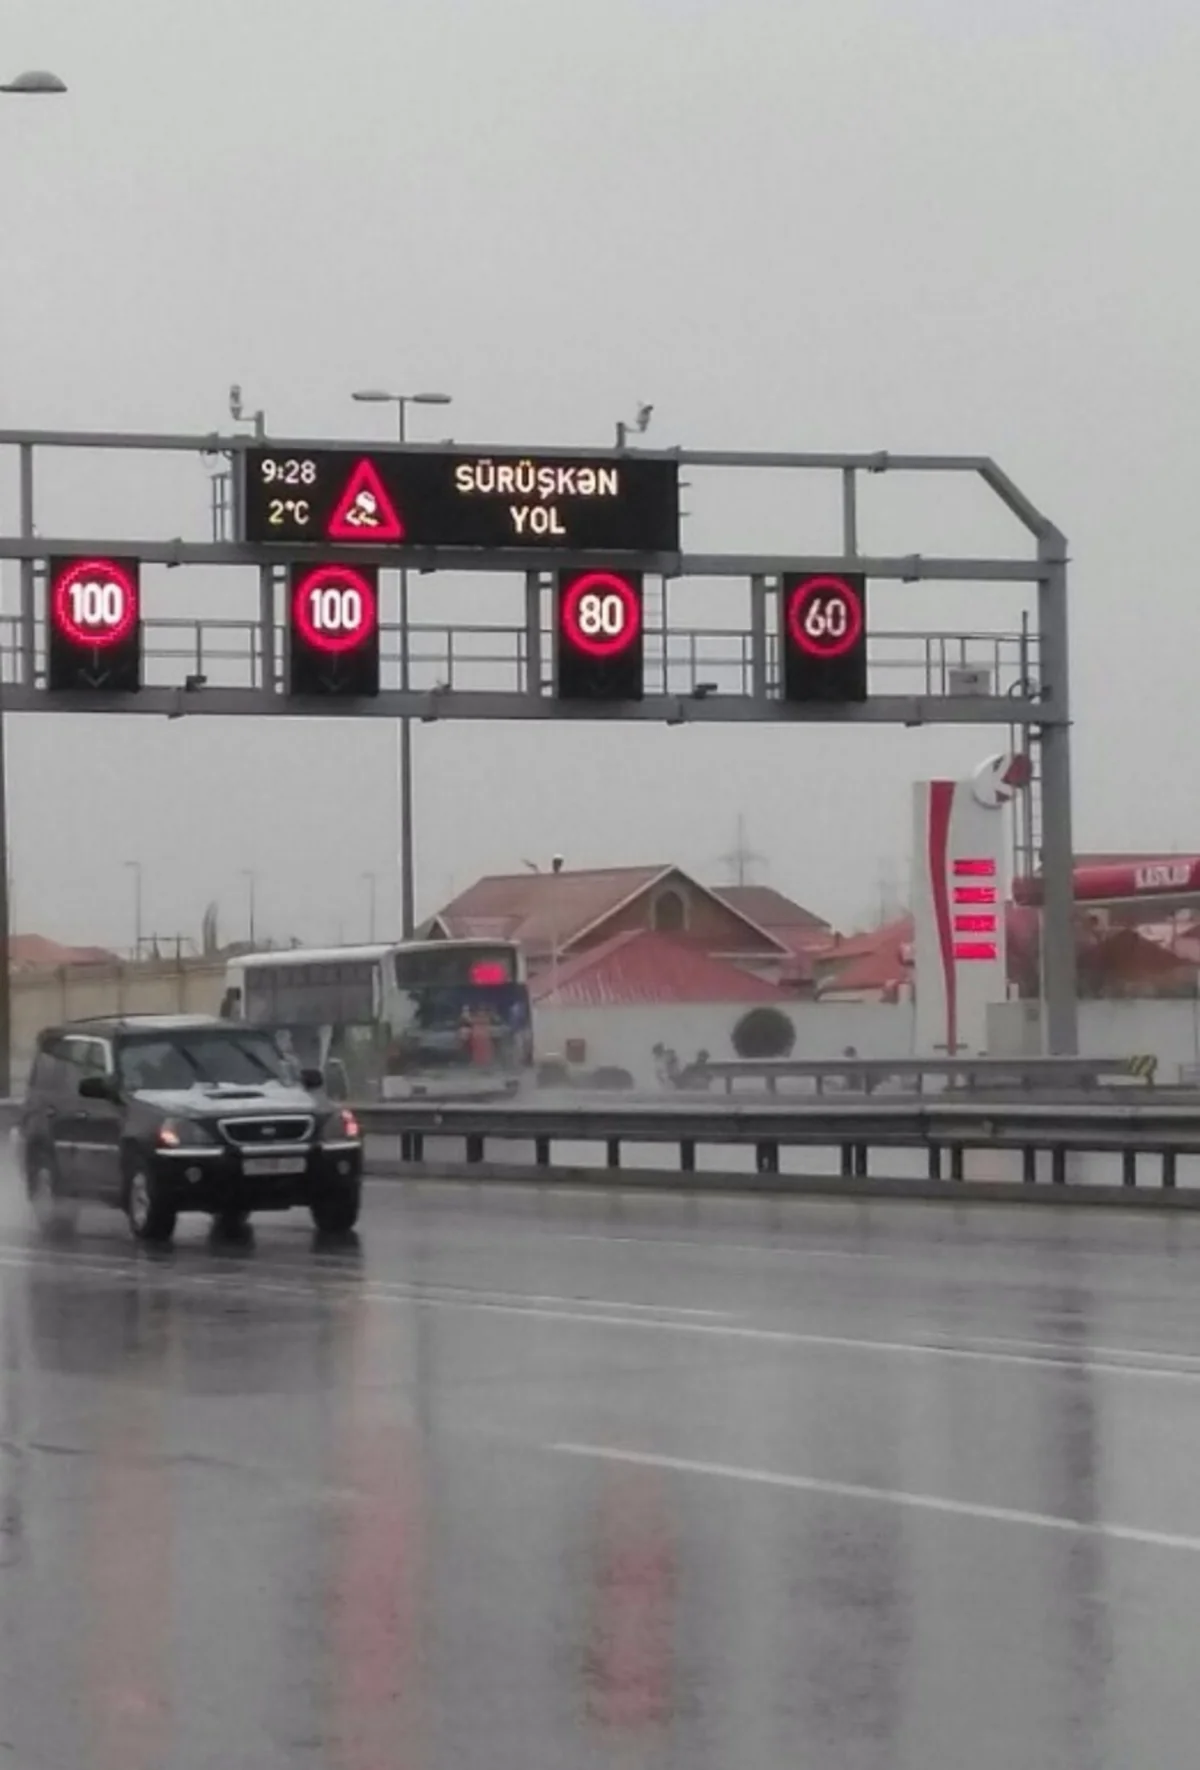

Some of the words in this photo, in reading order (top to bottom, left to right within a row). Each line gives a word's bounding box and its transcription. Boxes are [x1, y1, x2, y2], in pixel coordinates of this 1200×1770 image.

[261, 459, 316, 484] 9:28
[455, 458, 617, 499] SÜRÜŞKƏN
[269, 499, 308, 524] 2°C
[510, 506, 566, 535] YOL
[70, 582, 123, 624] 100
[310, 588, 361, 629] 100
[579, 594, 623, 634] 80
[804, 599, 846, 636] 60
